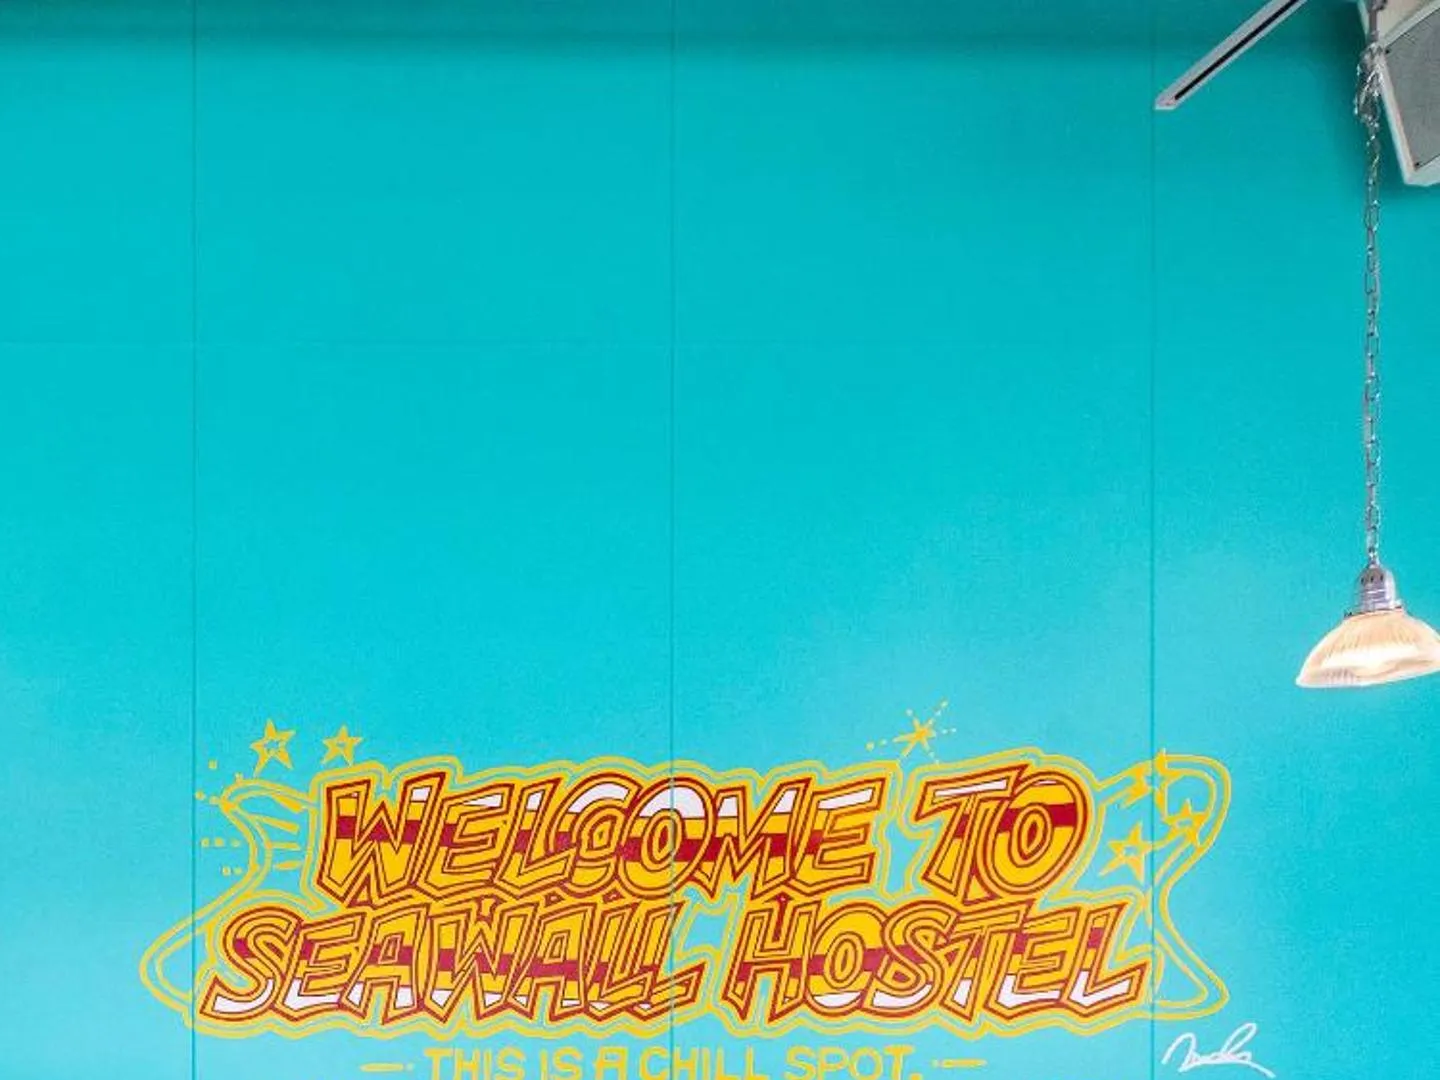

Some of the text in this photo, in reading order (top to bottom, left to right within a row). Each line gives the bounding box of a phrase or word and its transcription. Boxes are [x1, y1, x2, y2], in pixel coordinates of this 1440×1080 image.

[316, 764, 1091, 907] WELCOME TO
[200, 894, 1151, 1025] SEAWALL HOSTEL
